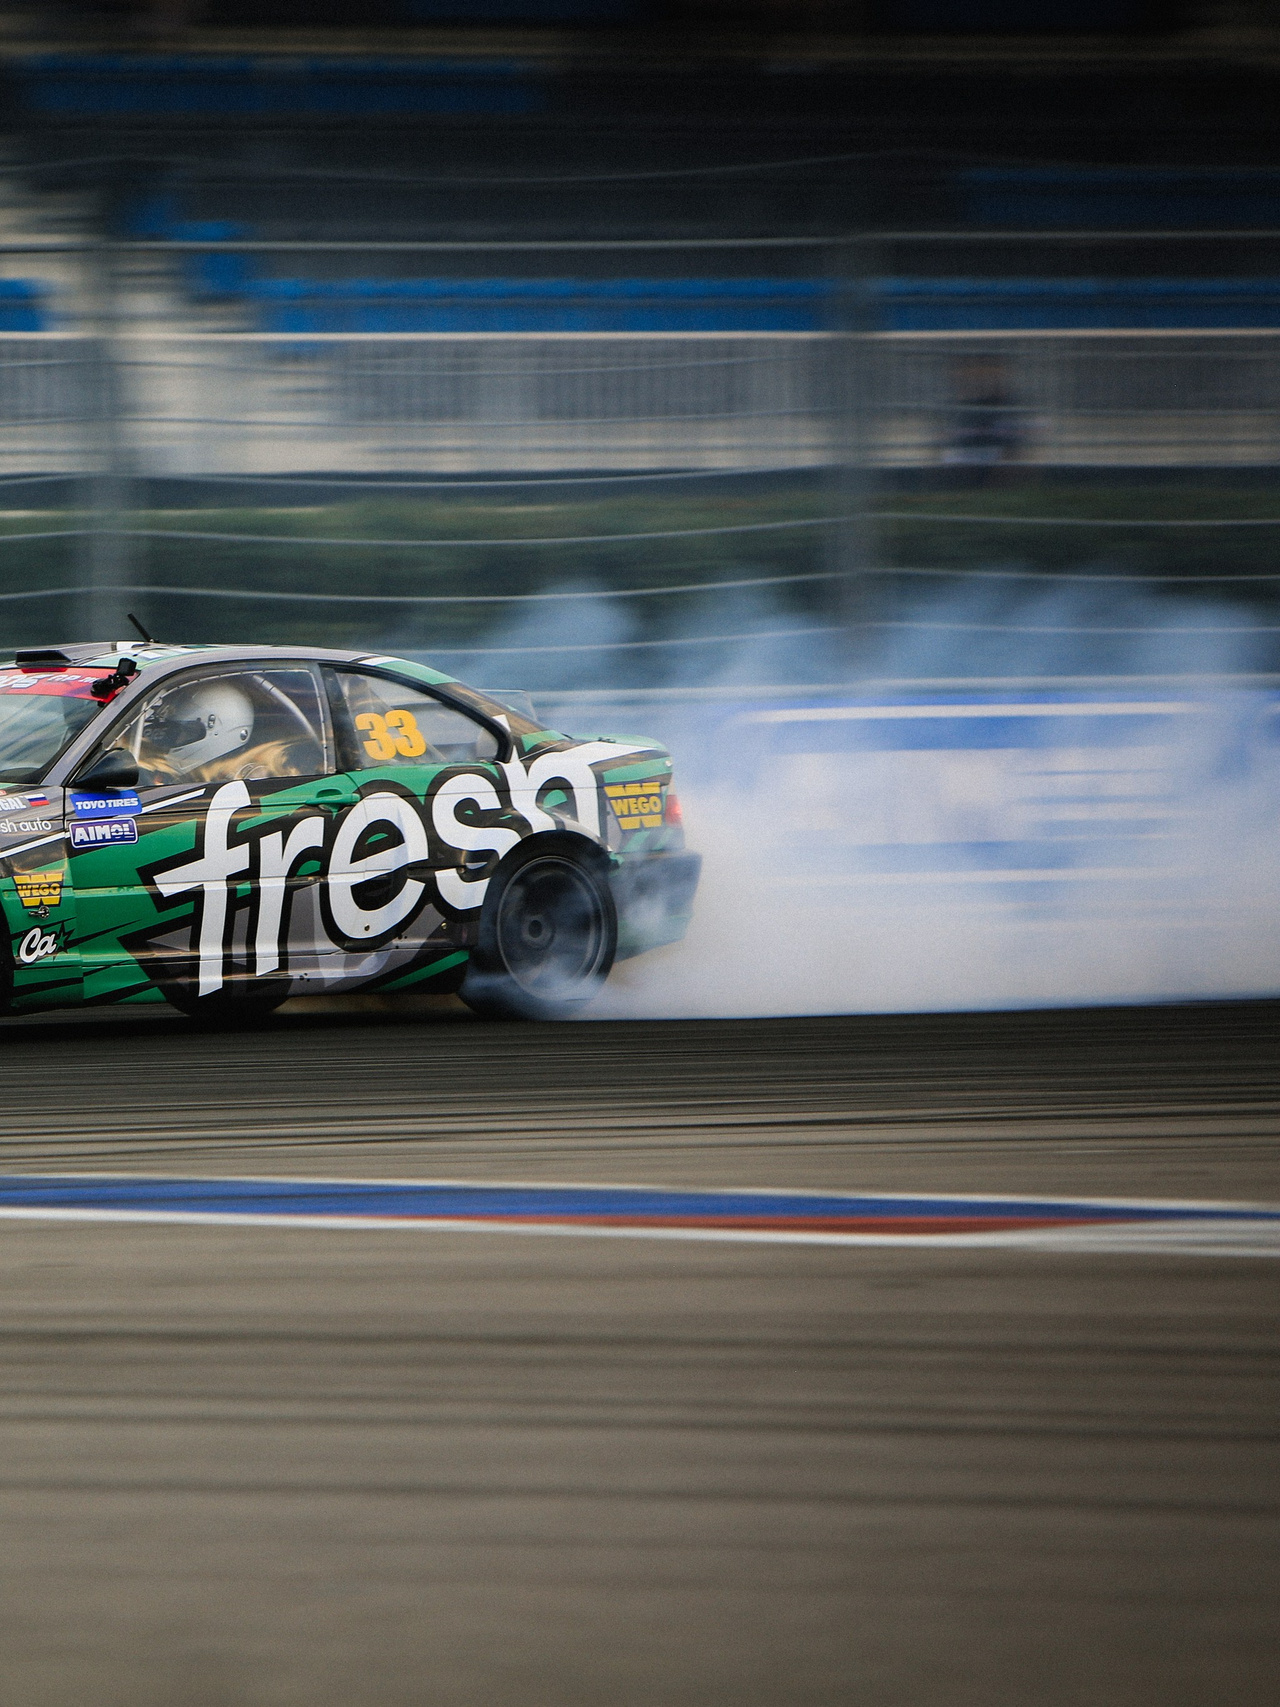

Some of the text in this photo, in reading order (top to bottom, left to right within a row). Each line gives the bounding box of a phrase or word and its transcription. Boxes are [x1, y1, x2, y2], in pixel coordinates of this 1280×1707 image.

[354, 709, 427, 761] 33
[75, 797, 139, 811] TOYO TIRES
[610, 795, 662, 816] WEGO
[19, 817, 52, 832] auto
[74, 824, 135, 843] AIMOL
[152, 713, 654, 998] fresh
[17, 883, 61, 897] WEGO
